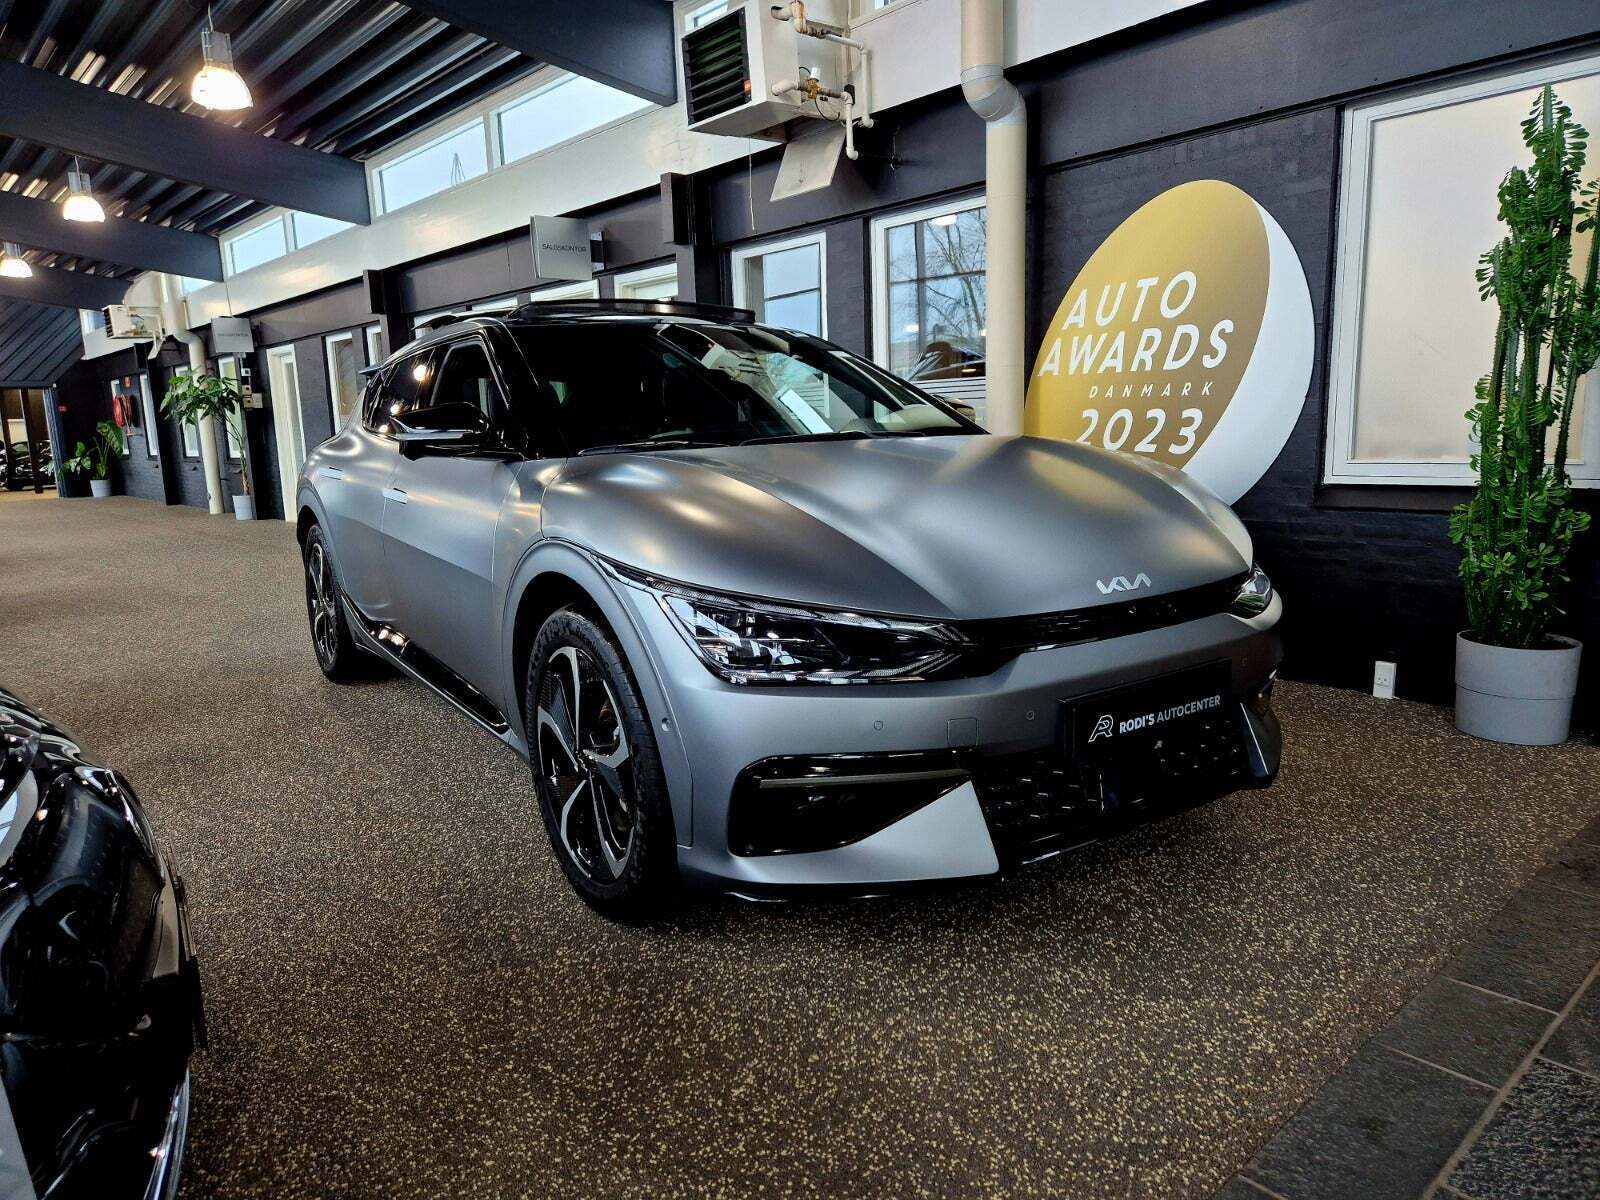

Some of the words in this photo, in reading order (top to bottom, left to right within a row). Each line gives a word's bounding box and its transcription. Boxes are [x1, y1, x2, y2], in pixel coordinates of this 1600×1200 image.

[1062, 270, 1197, 330] AUTO
[1038, 319, 1234, 377] AWARDS
[1089, 381, 1214, 399] DANMARK
[1076, 408, 1203, 455] 2023
[1096, 572, 1152, 595] KIA
[1119, 713, 1155, 734] RODI'S
[1156, 694, 1221, 723] AUTOCENTER
